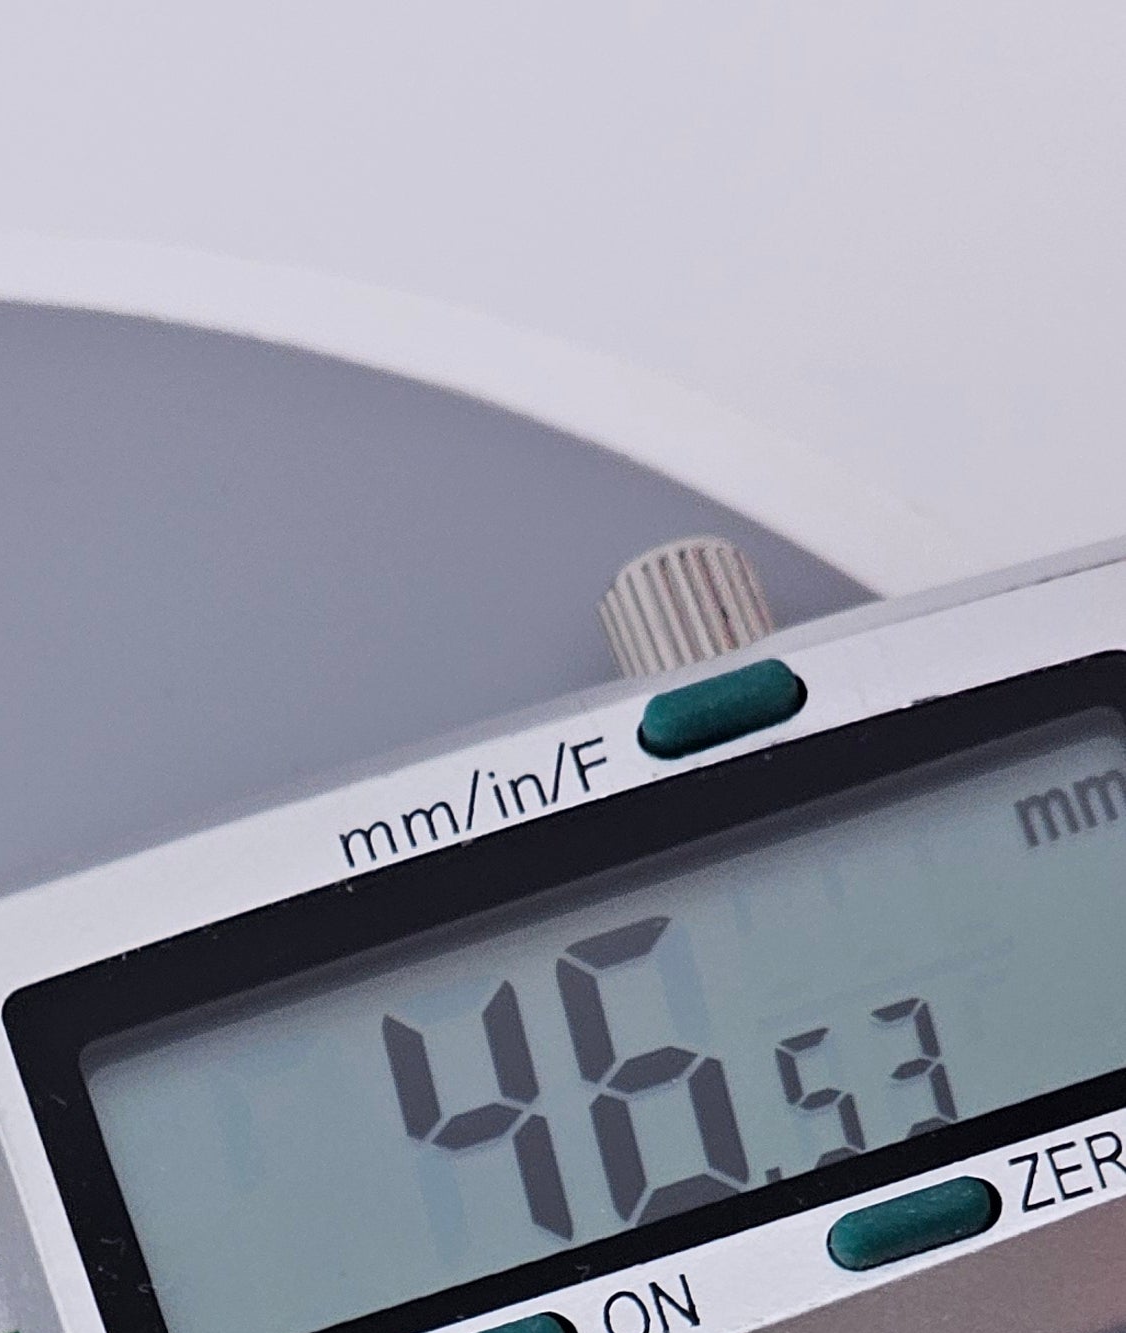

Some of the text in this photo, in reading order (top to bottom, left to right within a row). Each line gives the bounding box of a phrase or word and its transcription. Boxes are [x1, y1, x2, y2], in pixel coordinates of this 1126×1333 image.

[338, 737, 609, 868] mm/in/F
[1014, 769, 1126, 848] mm
[381, 915, 958, 1242] 46.53
